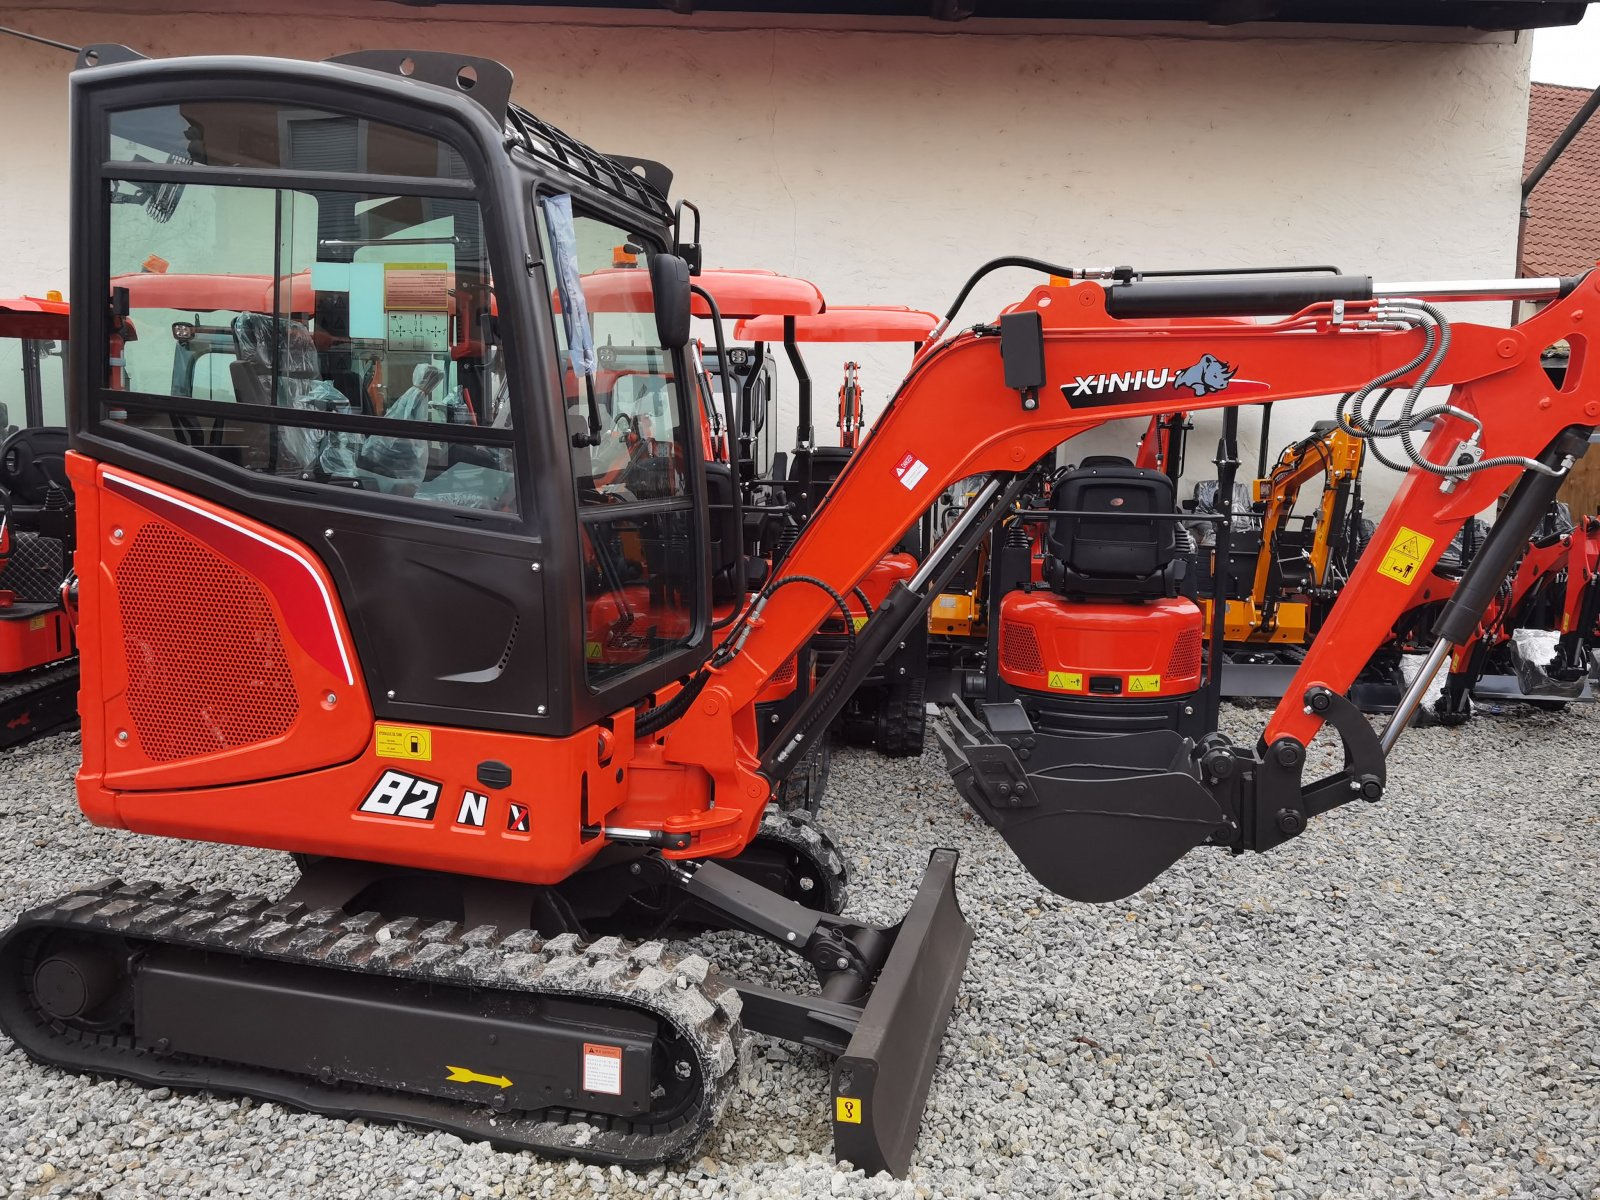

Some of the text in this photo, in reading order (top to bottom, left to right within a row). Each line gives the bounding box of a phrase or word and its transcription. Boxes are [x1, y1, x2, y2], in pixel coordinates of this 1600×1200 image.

[1072, 367, 1170, 396] XINIU
[360, 770, 528, 832] 82 N X
